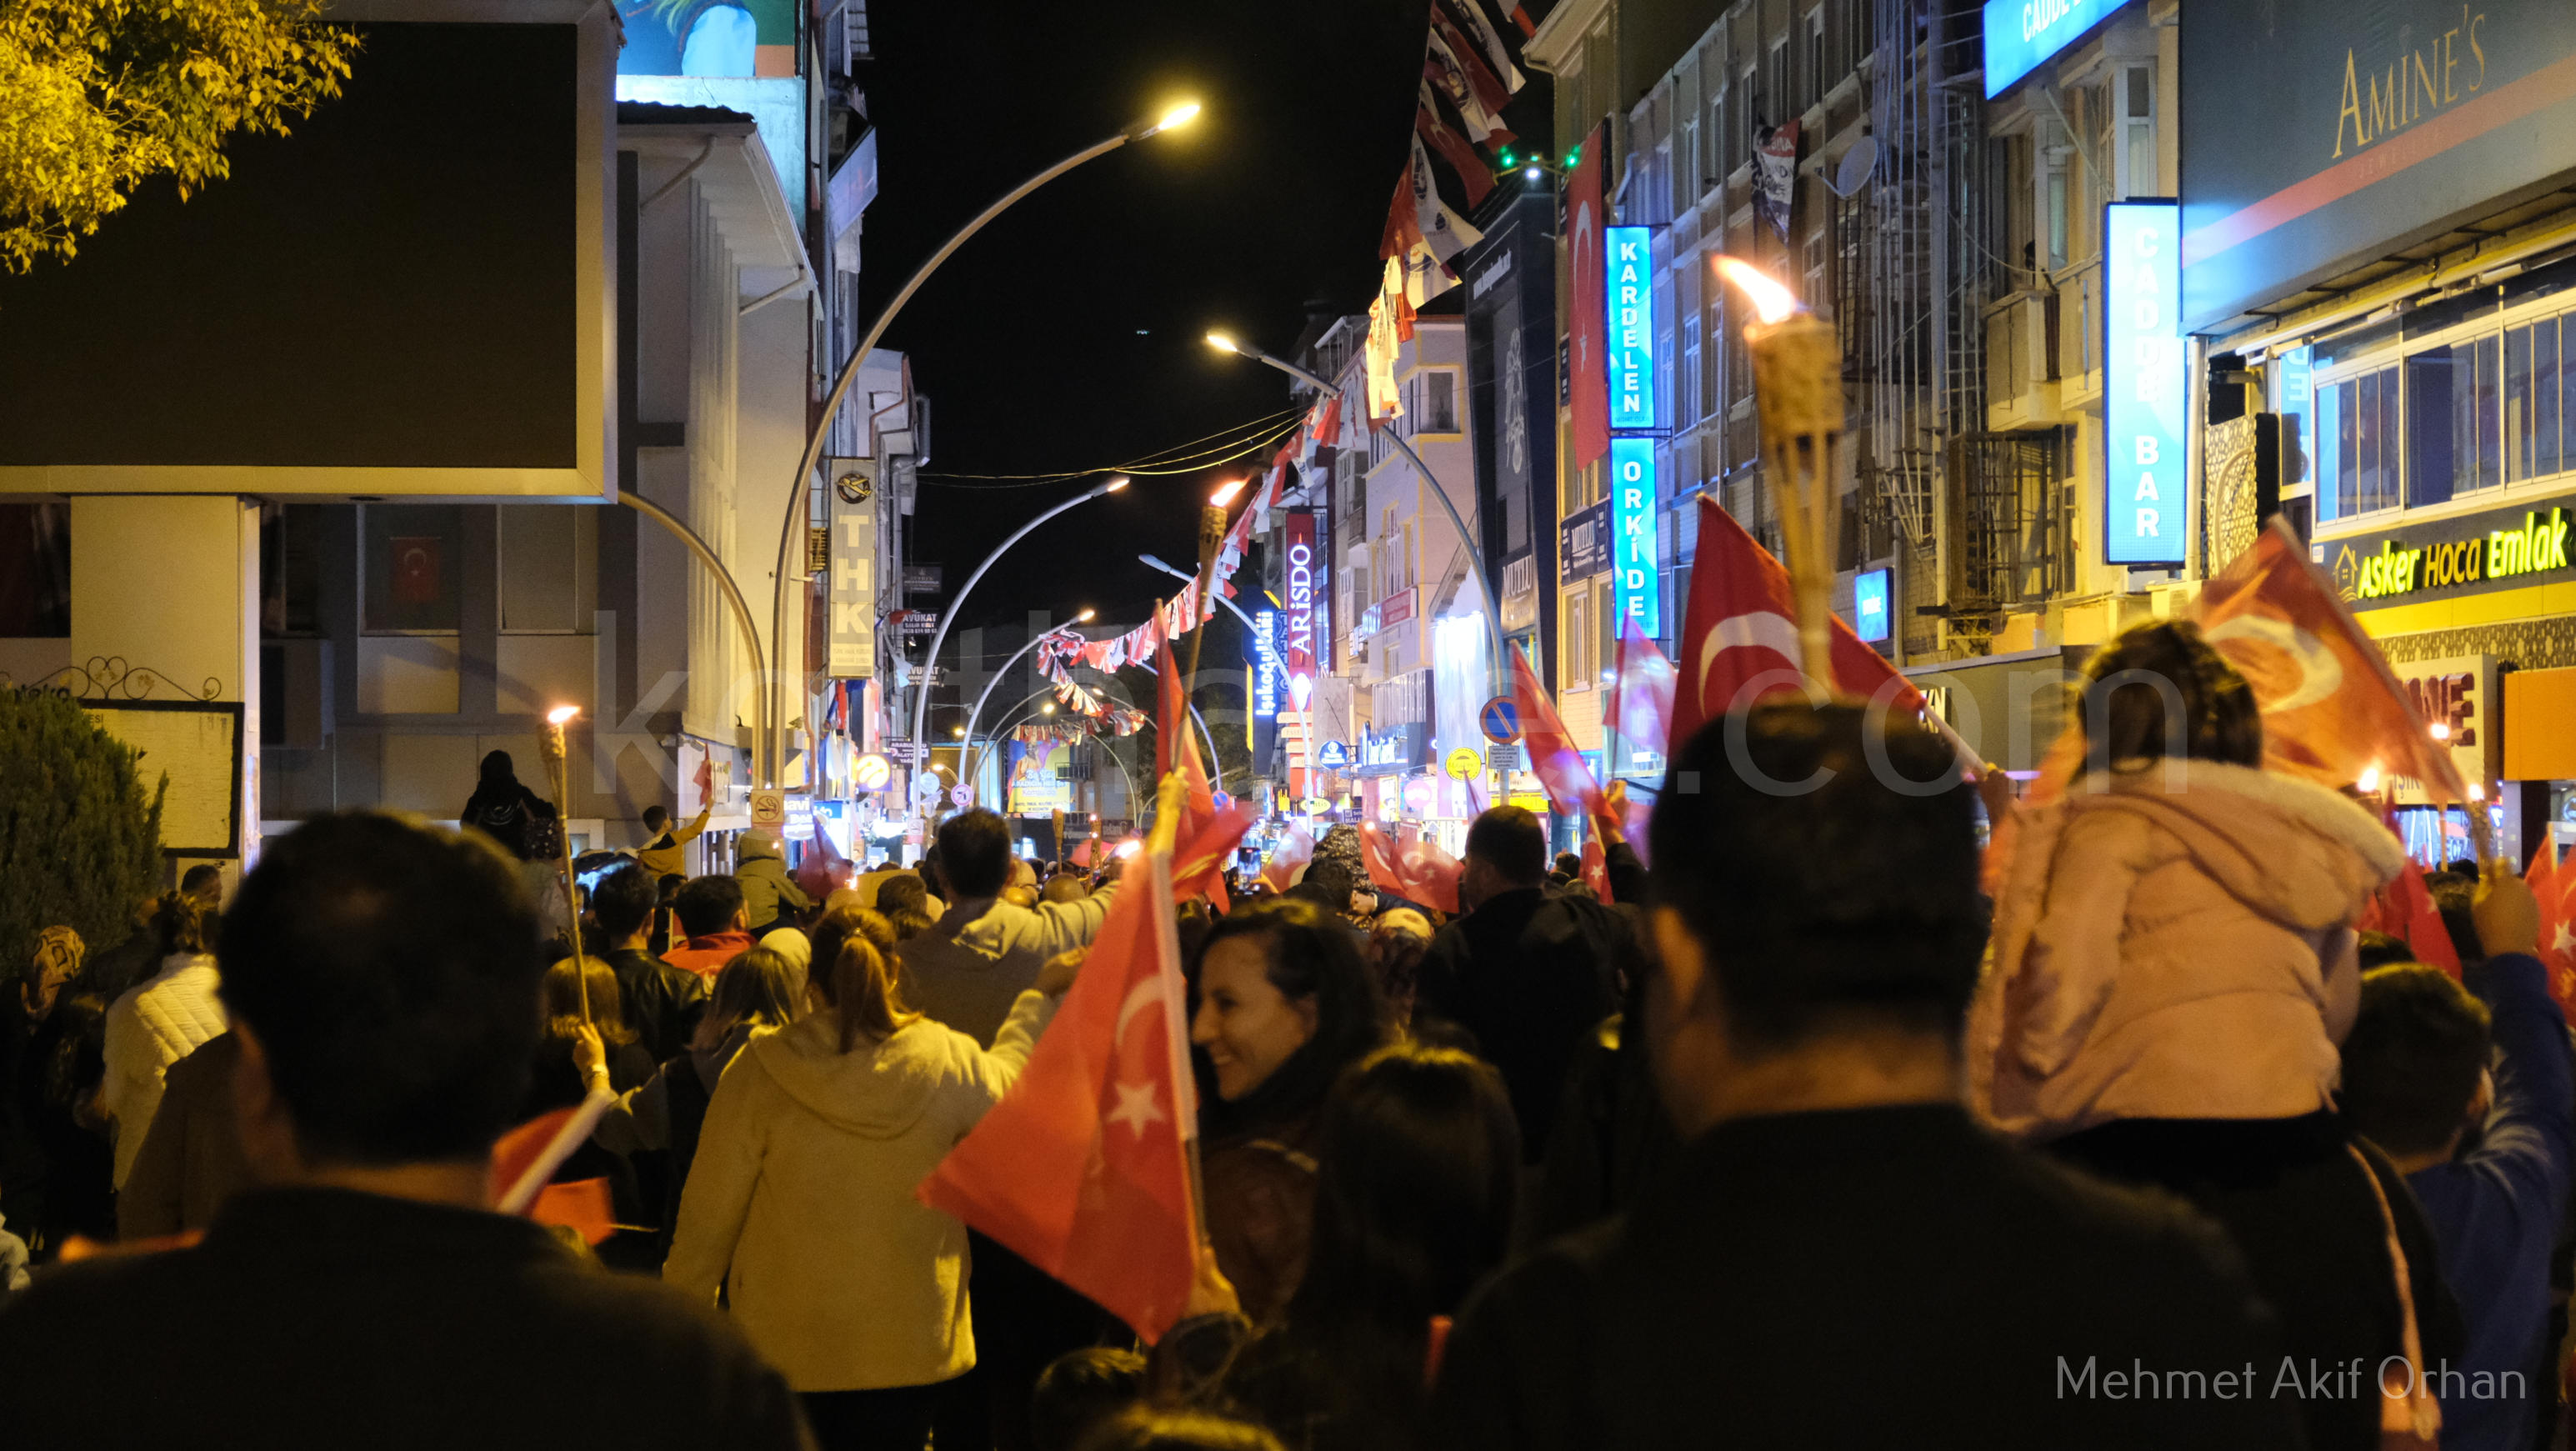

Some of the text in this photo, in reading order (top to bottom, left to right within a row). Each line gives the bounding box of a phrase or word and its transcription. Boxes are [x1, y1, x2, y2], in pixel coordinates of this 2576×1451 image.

[1620, 242, 1640, 413] KARDELEN
[2134, 227, 2160, 537] CADDE BAR
[836, 514, 869, 633] THK
[1623, 461, 1646, 617] ORKİDE
[2487, 507, 2568, 578] Emlak
[903, 613, 937, 622] AVUKAT
